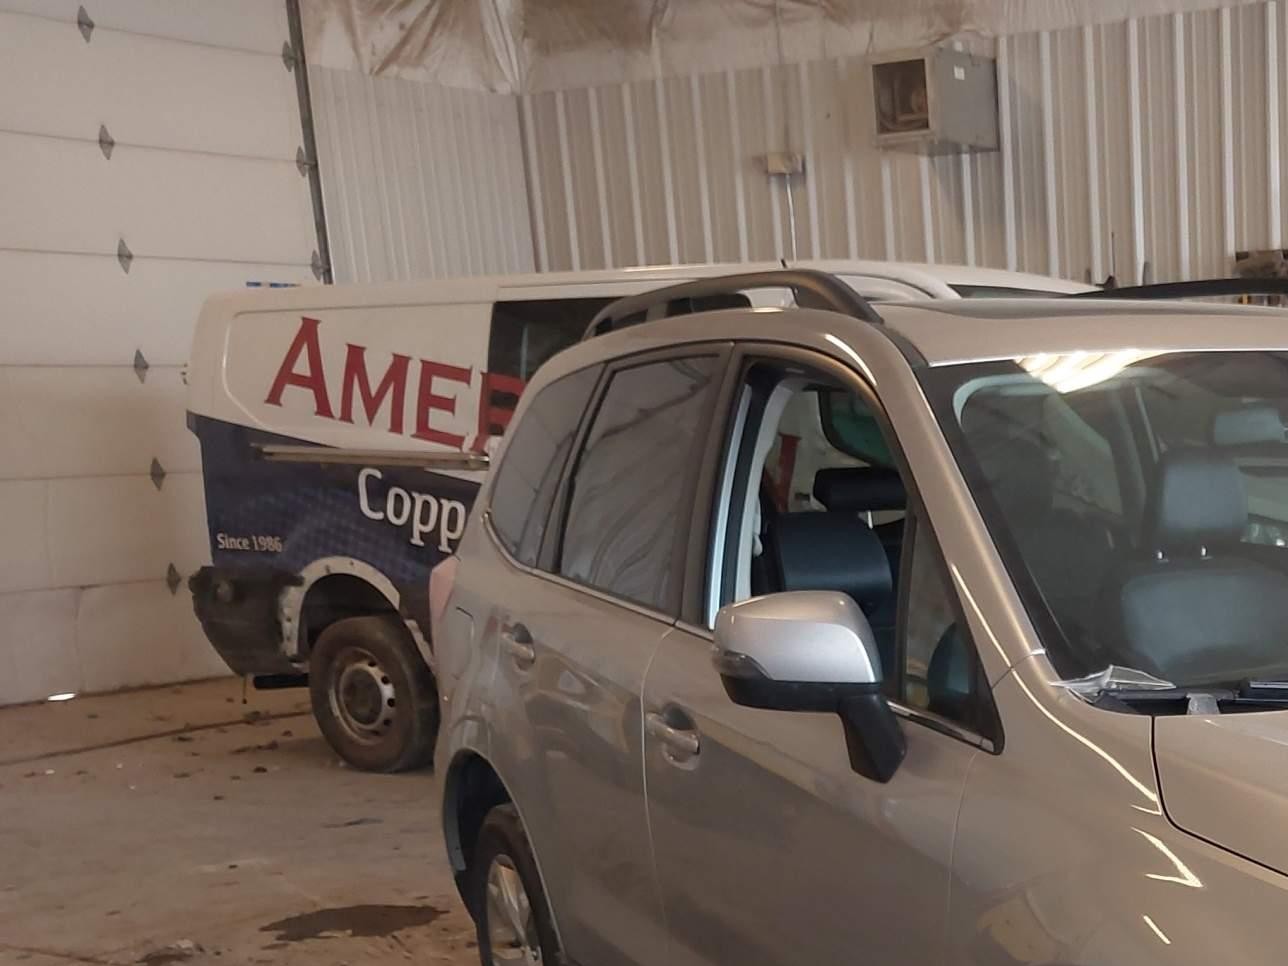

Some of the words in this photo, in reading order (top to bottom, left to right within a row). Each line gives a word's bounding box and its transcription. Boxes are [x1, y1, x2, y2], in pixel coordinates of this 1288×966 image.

[358, 468, 466, 553] Copp
[216, 533, 250, 550] Since
[252, 535, 283, 553] 1986
